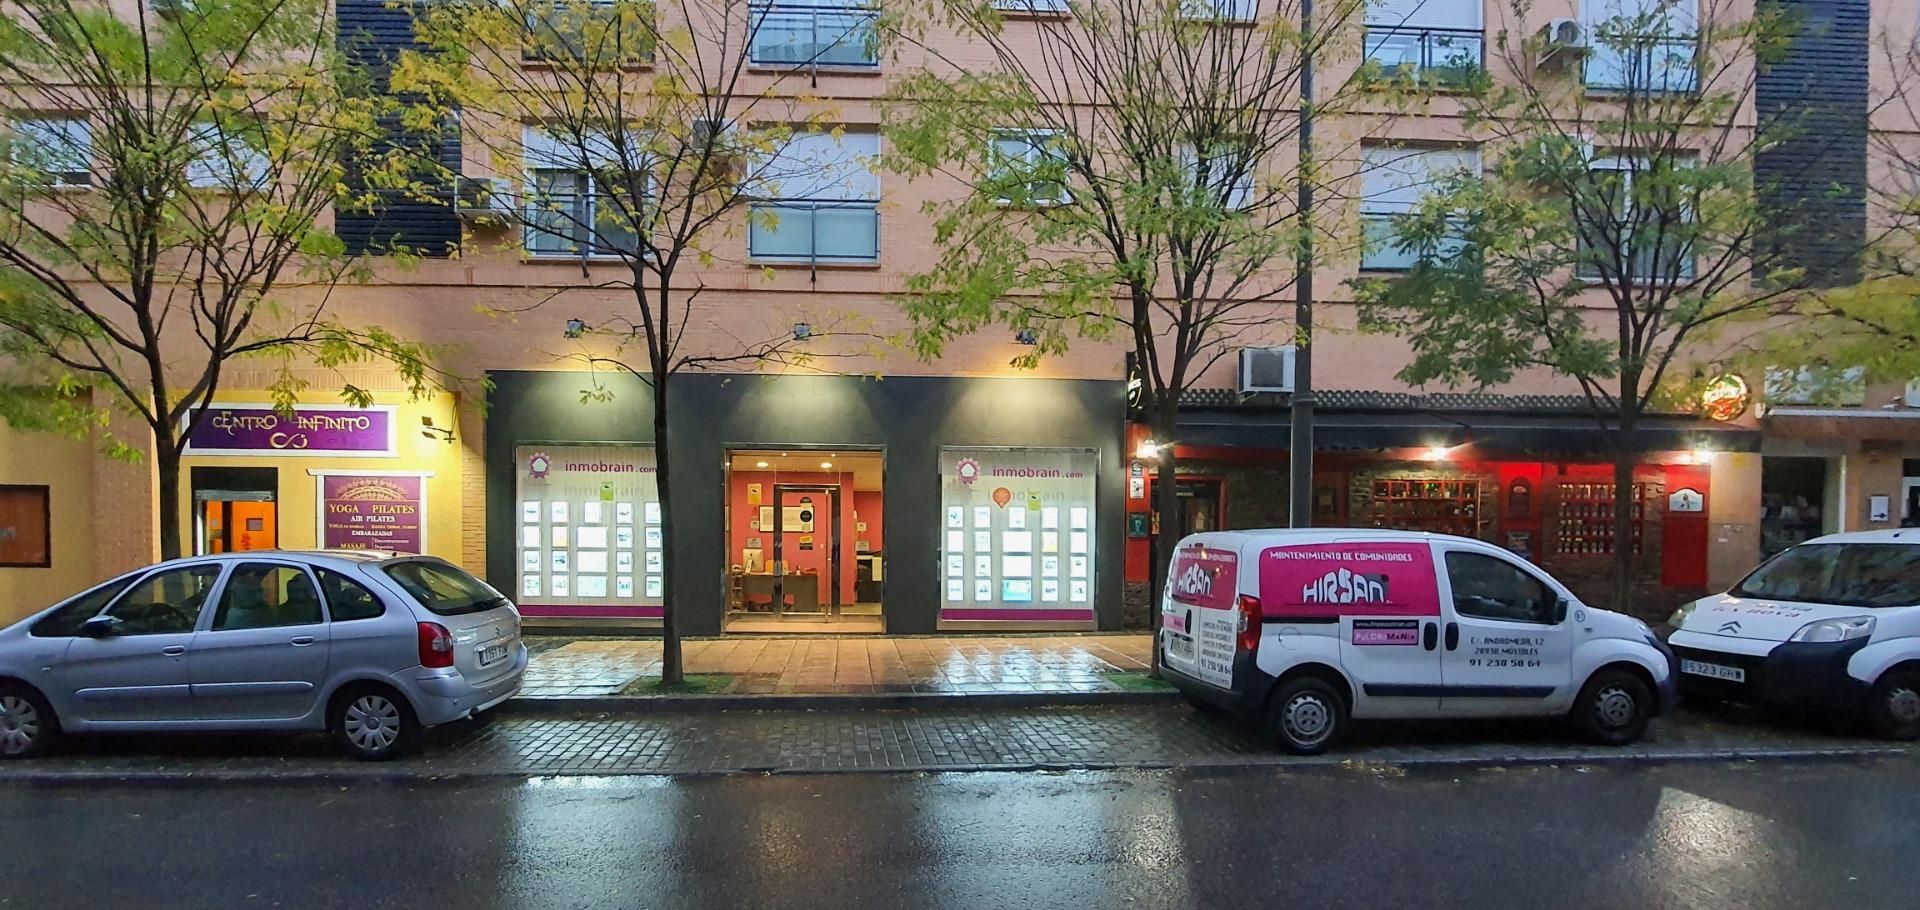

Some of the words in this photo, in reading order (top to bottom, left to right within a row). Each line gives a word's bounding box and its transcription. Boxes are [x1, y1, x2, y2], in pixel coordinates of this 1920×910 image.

[212, 411, 278, 435] CENTRO
[293, 415, 370, 432] INFINITO
[329, 504, 359, 513] YOGA
[372, 504, 415, 514] PILATES
[1270, 551, 1341, 560] MANTENIMIENTO
[1342, 551, 1353, 560] DE
[1354, 552, 1413, 562] COMUNIDADES
[1178, 562, 1211, 596] HIRSAN
[1303, 567, 1384, 604] HIRSAN
[1469, 659, 1482, 667] 91
[1689, 661, 1717, 676] 5323
